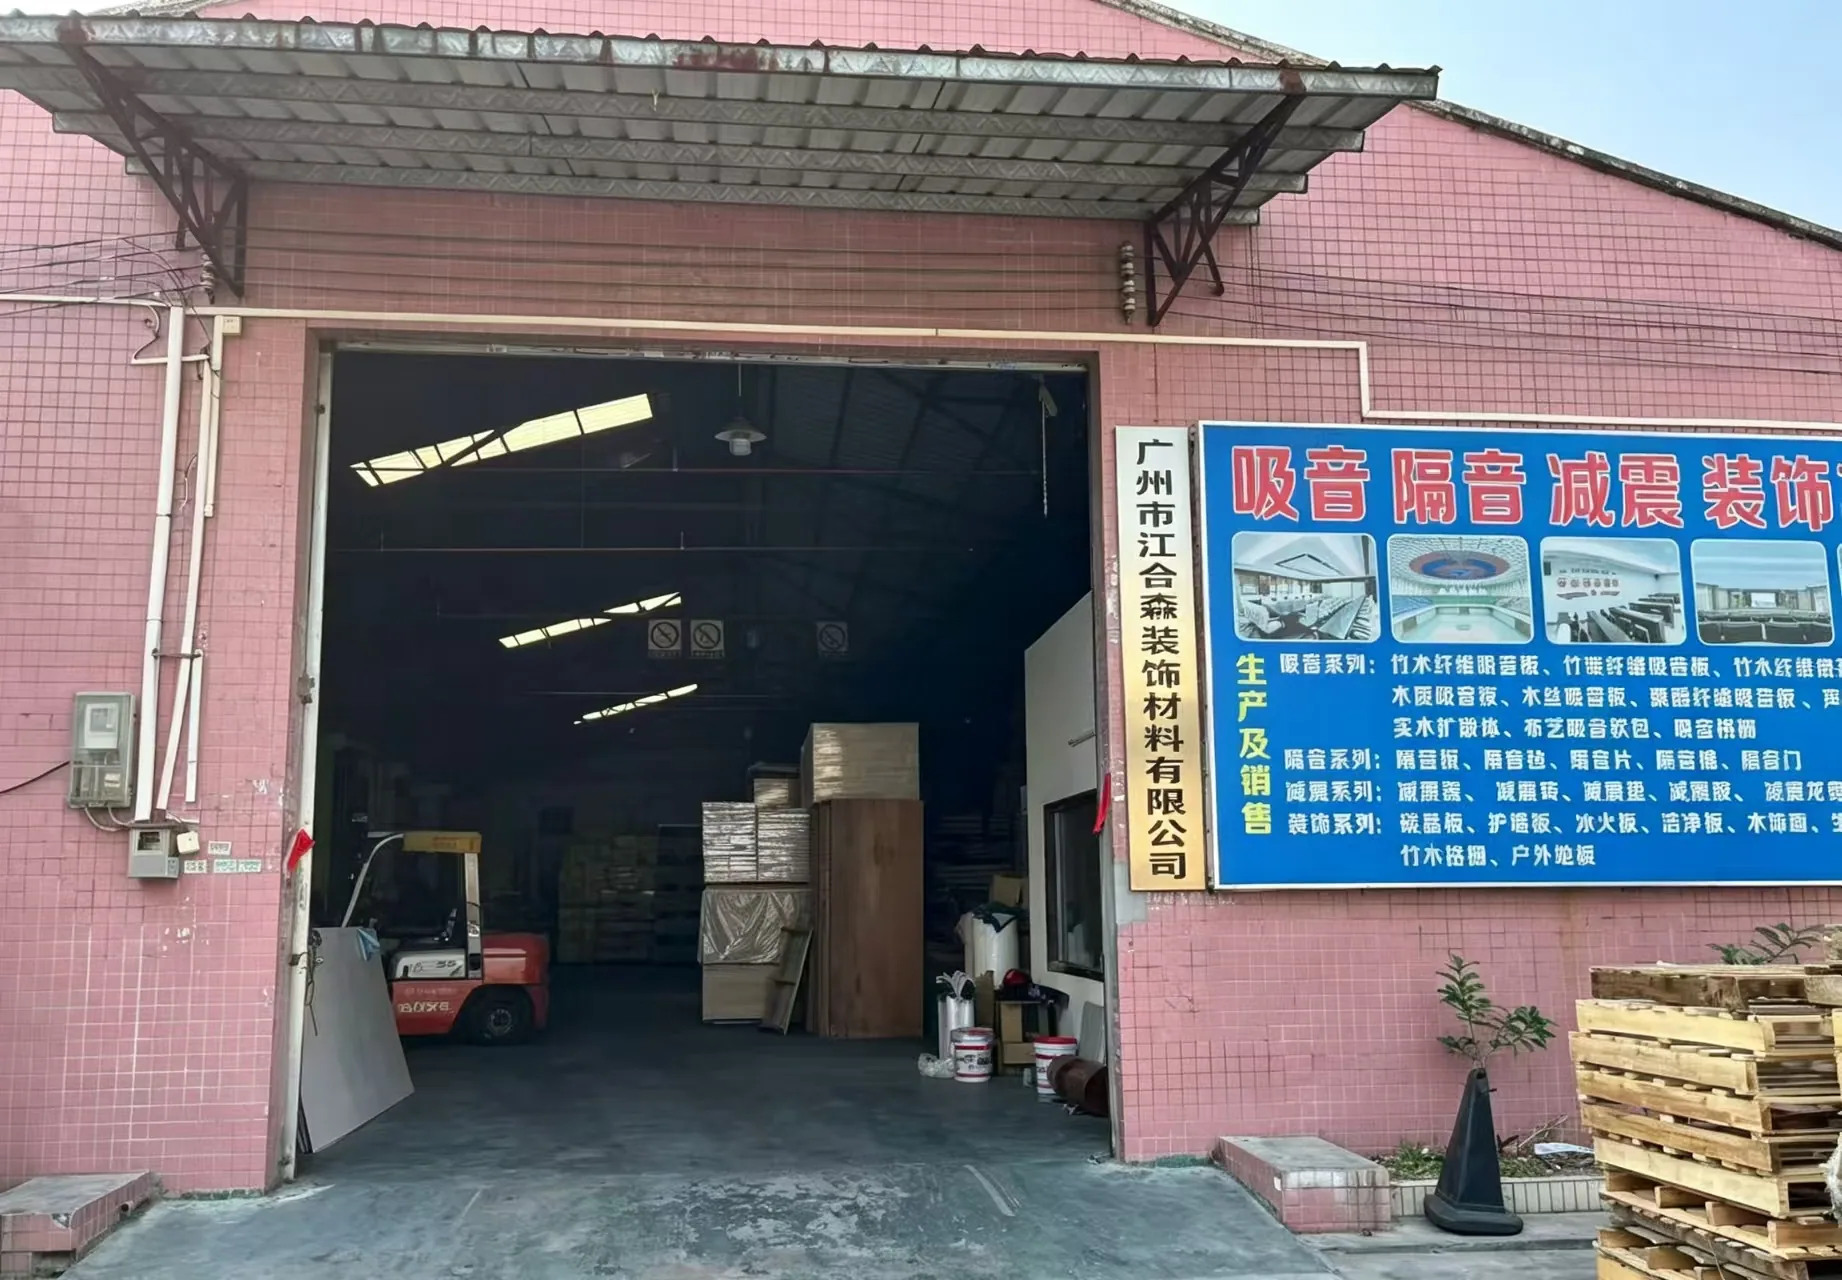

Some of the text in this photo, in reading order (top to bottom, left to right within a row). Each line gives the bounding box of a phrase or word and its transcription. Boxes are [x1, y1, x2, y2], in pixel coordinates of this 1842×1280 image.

[1231, 445, 1842, 532] 吸音 隔音 减震 装饰
[1136, 438, 1188, 879] 广州市江合森装饰材料有限公司
[1236, 652, 1271, 834] 生产及销售
